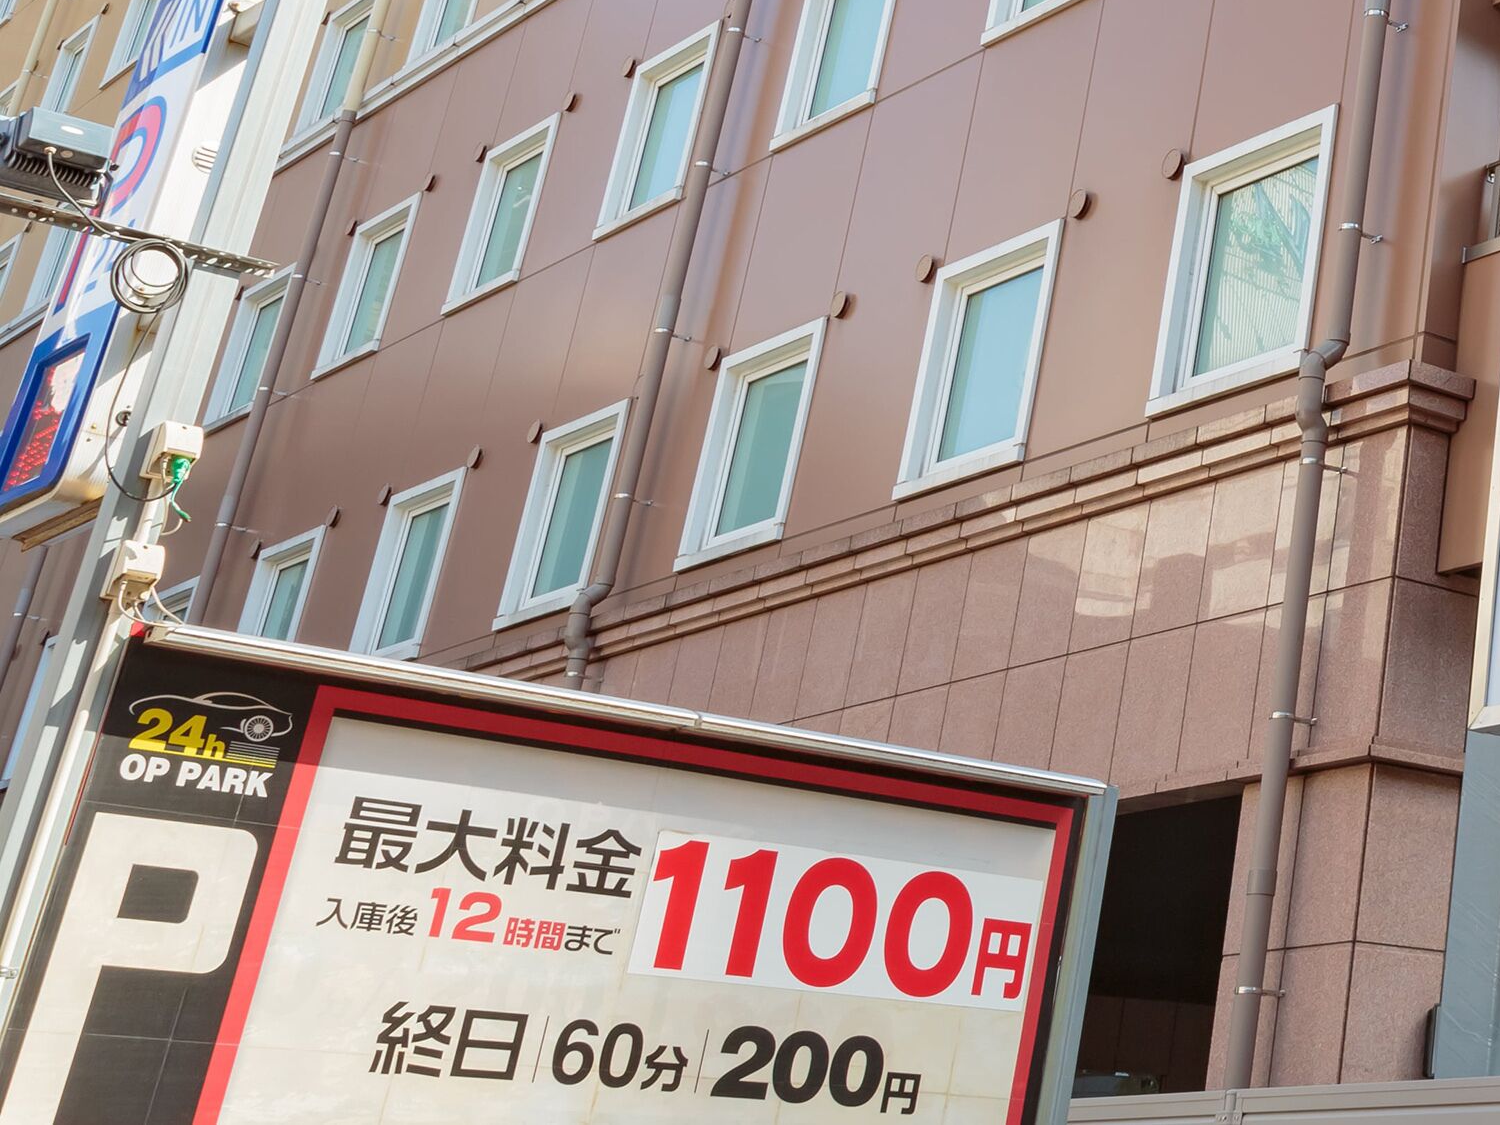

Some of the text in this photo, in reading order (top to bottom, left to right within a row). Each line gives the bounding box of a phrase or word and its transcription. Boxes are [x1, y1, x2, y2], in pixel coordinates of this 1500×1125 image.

[119, 753, 274, 798] OP PARK
[128, 708, 226, 759] 24h
[333, 795, 1033, 1000] 最大料金 1100円
[0, 811, 259, 1125] P
[368, 1001, 922, 1115] 終日 60分 200円
